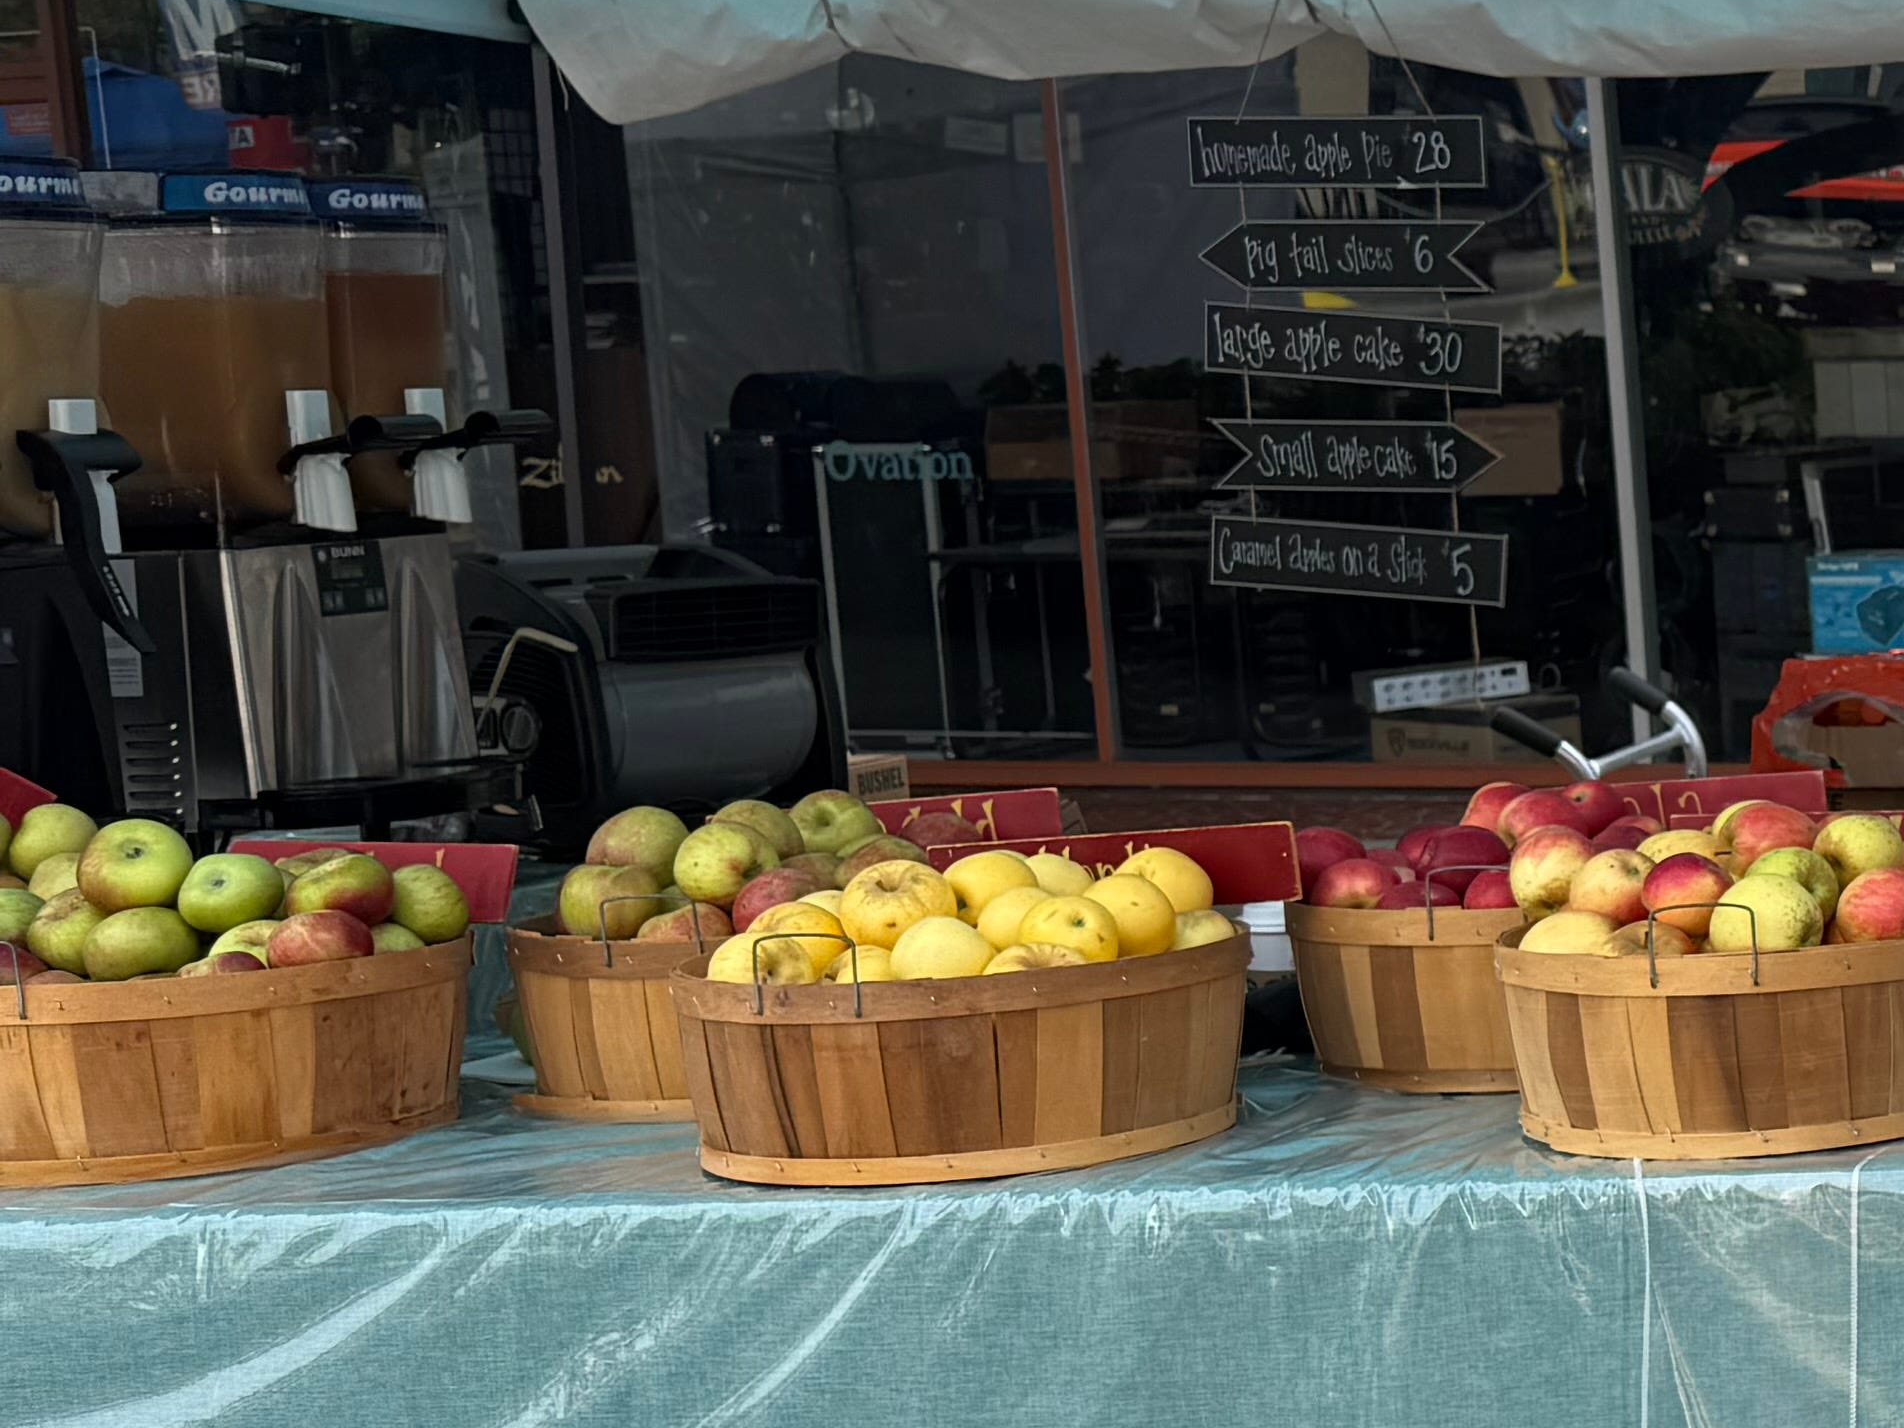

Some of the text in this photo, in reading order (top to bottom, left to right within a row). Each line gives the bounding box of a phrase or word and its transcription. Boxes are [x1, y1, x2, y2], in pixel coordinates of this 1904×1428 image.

[1197, 126, 1296, 178] homemade
[1304, 132, 1352, 179] apple
[1289, 232, 1329, 277] tail
[1213, 311, 1275, 369] large
[1284, 320, 1343, 376] apple
[1353, 326, 1404, 371] cake
[824, 441, 975, 483] Ovation
[857, 766, 905, 797] BUSHEL
